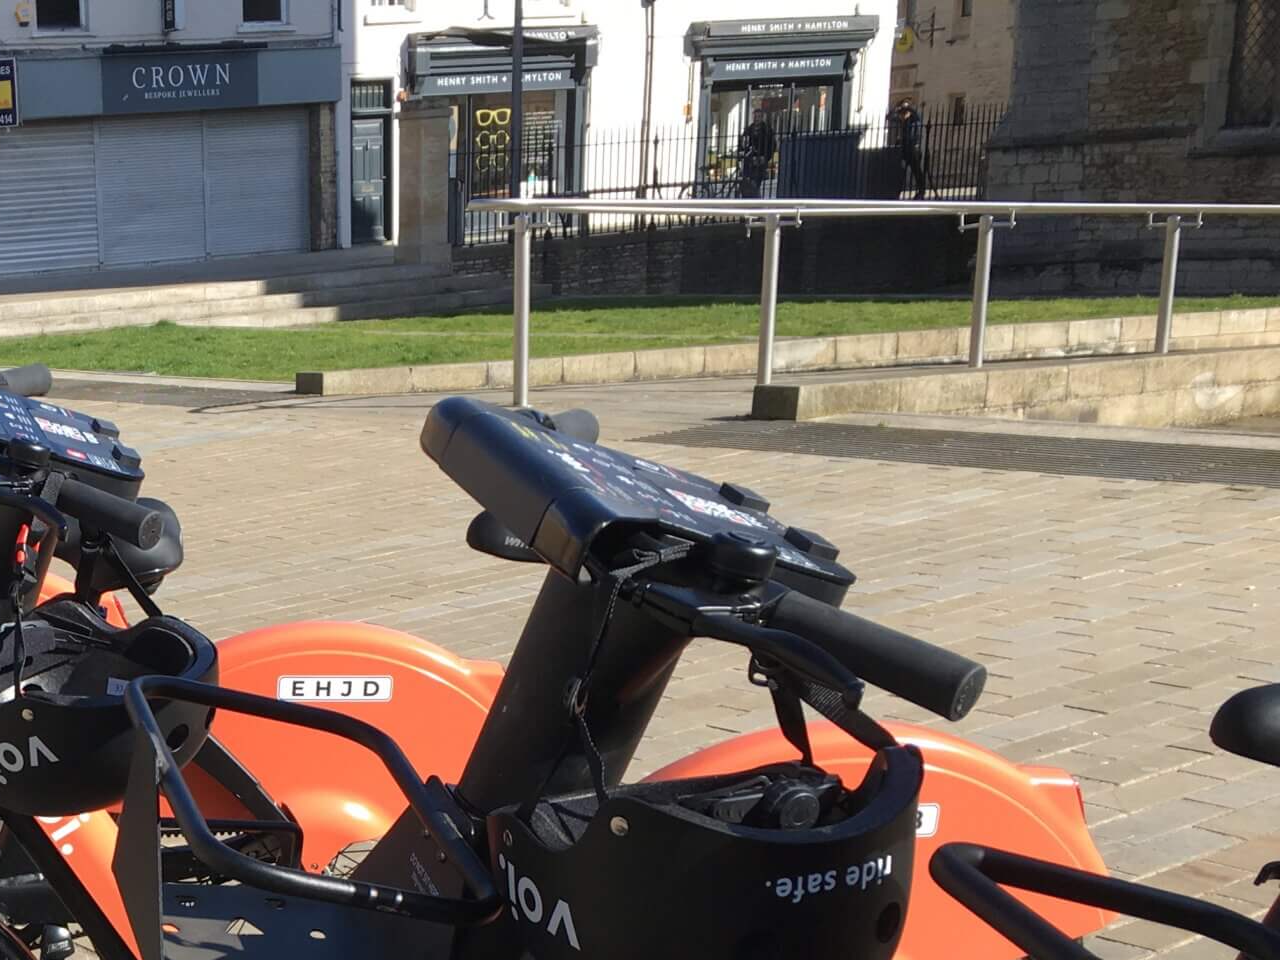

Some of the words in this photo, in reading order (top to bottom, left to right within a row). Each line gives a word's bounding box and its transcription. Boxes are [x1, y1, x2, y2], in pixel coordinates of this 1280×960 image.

[741, 23, 766, 33] HENRY
[769, 22, 794, 32] SMITH
[804, 20, 849, 31] HAMYLTON
[725, 62, 750, 72] HENRY
[754, 60, 778, 71] SMITH
[788, 58, 832, 70] HAMYLTON
[132, 62, 231, 89] CROWN
[437, 75, 466, 87] HENRY
[470, 74, 498, 85] SMITH
[521, 71, 562, 83] MYLTON
[144, 90, 177, 100] BESPOKE
[179, 88, 221, 98] JEWELLERS
[291, 680, 381, 697] EHJD
[845, 854, 893, 891] ride
[765, 869, 838, 903] safe.
